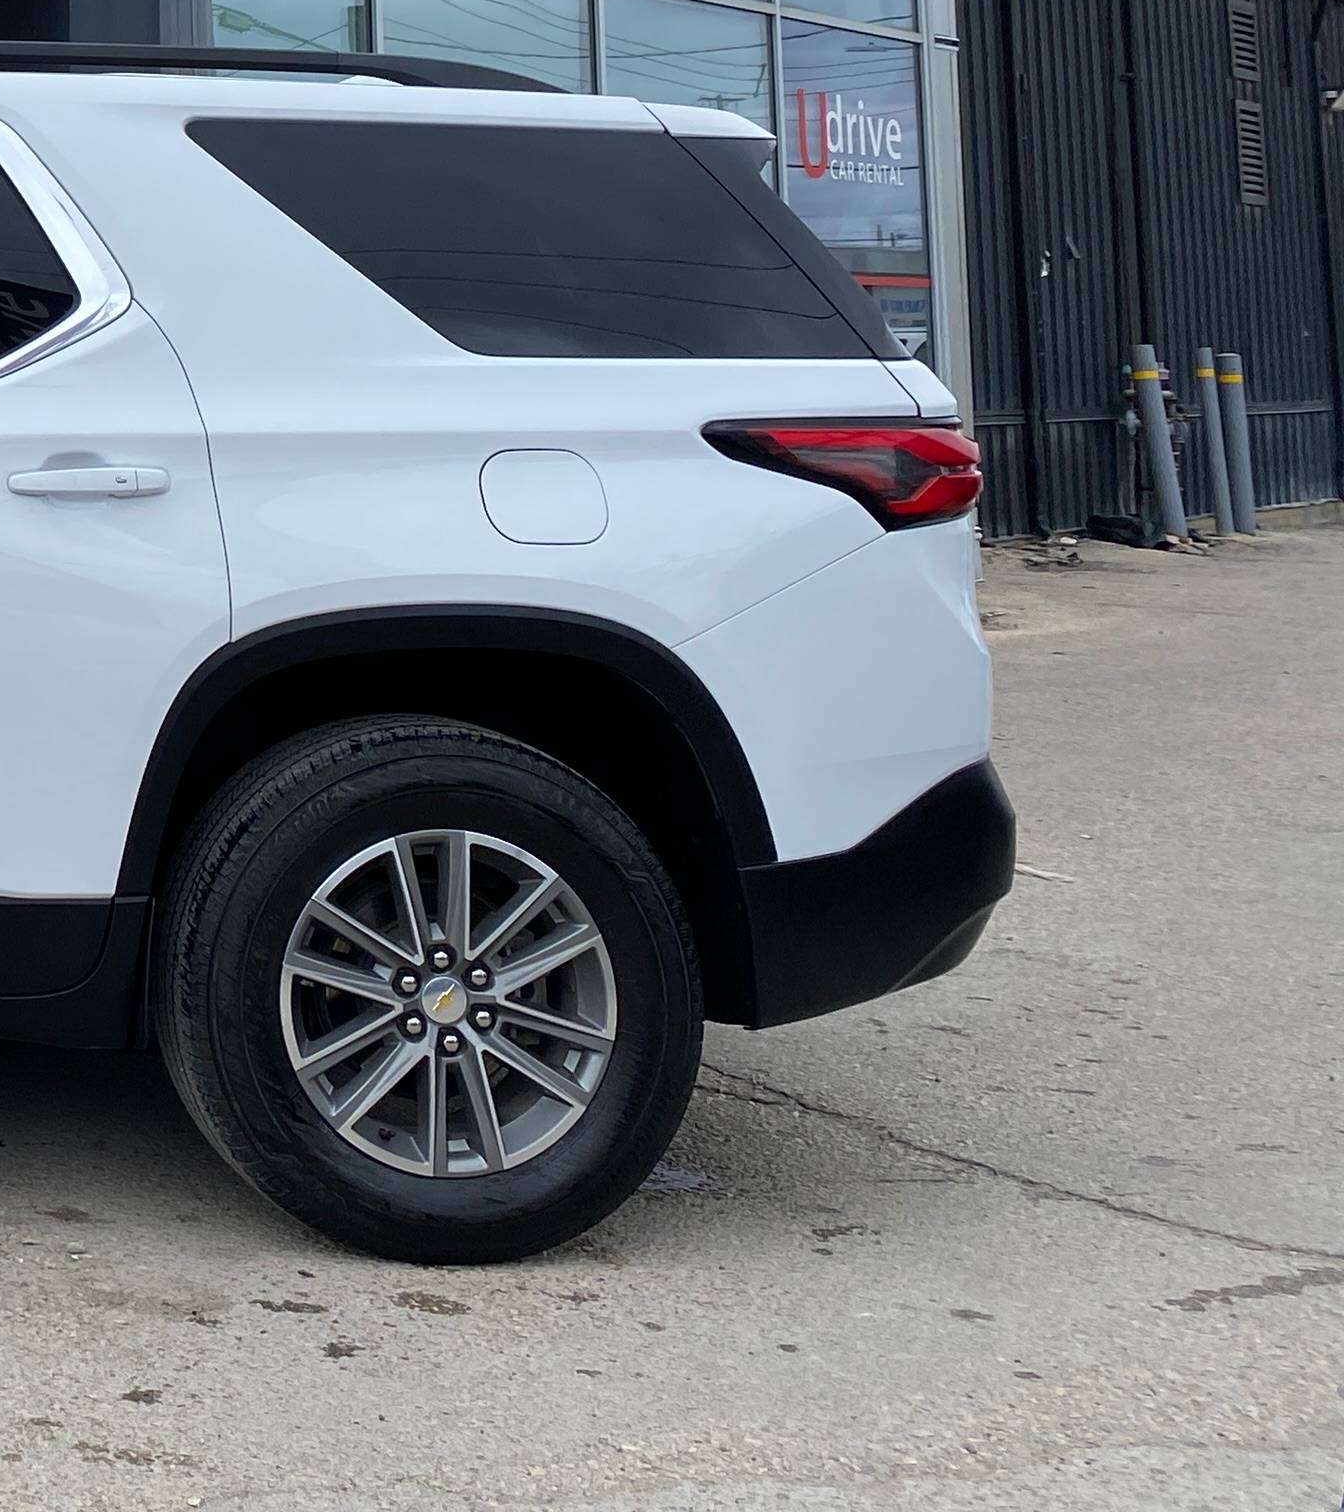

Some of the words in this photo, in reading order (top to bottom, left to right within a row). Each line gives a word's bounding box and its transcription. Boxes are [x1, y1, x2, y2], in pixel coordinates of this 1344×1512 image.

[796, 88, 902, 180] Udrive
[830, 159, 855, 181] CAR
[858, 162, 905, 186] RENTAL
